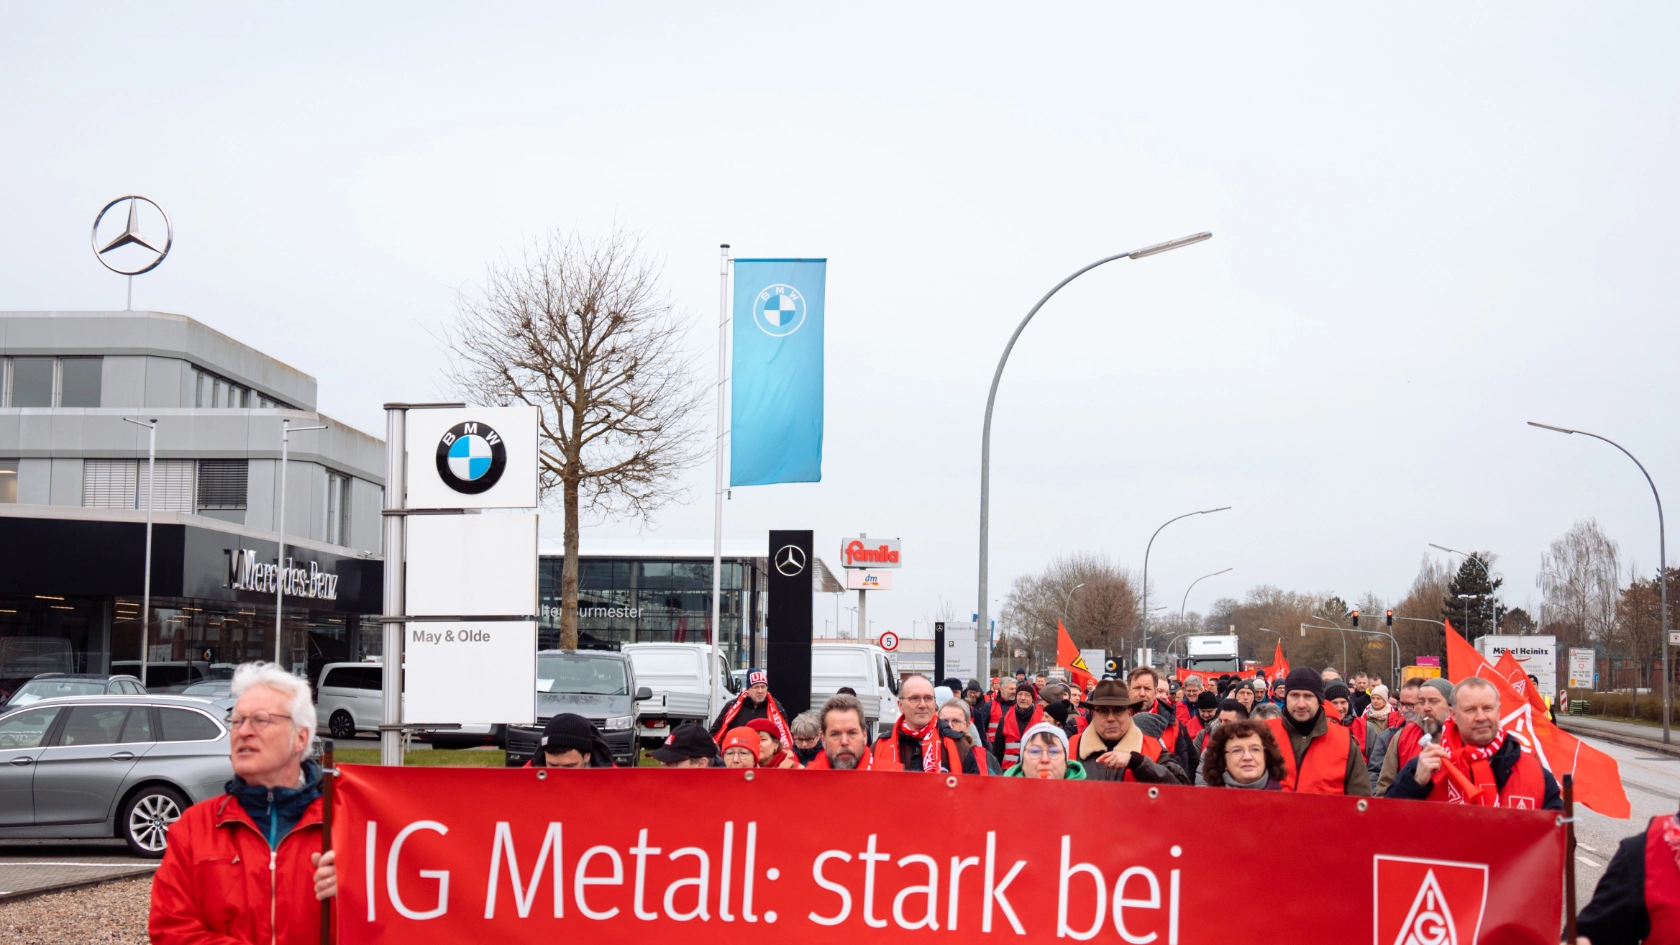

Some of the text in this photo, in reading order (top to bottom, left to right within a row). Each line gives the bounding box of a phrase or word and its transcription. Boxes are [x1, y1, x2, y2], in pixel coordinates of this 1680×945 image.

[761, 286, 799, 301] BMW
[442, 422, 501, 447] BMW
[845, 540, 899, 565] famila
[864, 574, 878, 582] dm
[577, 604, 644, 618] urmester
[412, 629, 491, 645] May & Olde
[886, 637, 892, 647] 5
[1493, 647, 1549, 655] Möel Heinitz
[365, 819, 1183, 945] IG Metall: stark bei
